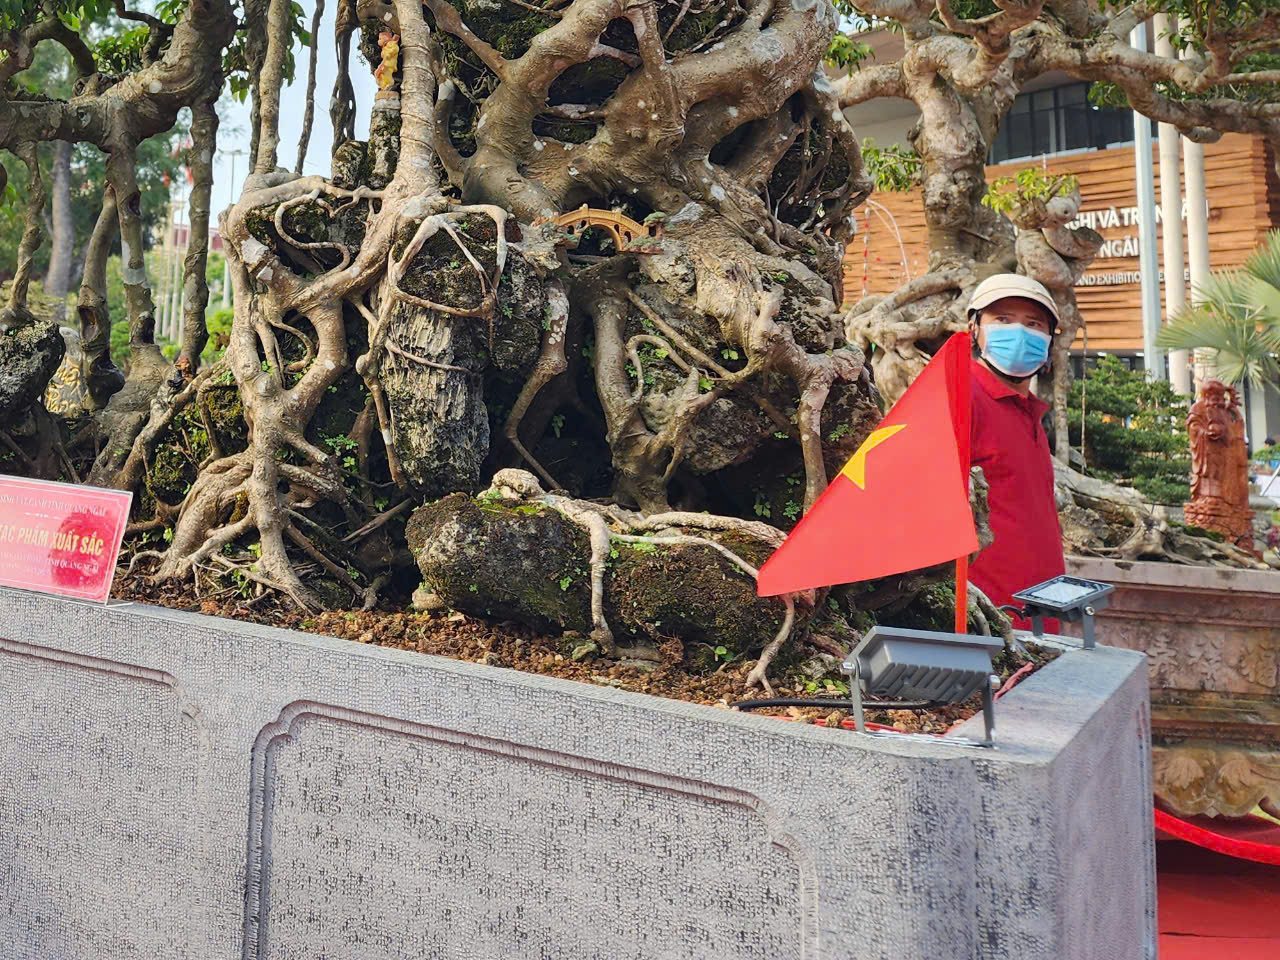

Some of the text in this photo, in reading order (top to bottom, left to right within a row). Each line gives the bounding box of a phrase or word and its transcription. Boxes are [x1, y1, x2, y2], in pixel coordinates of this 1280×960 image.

[1097, 206, 1120, 229] VÀ
[1097, 271, 1142, 285] EXHIBITIO
[80, 531, 104, 556] SẮC
